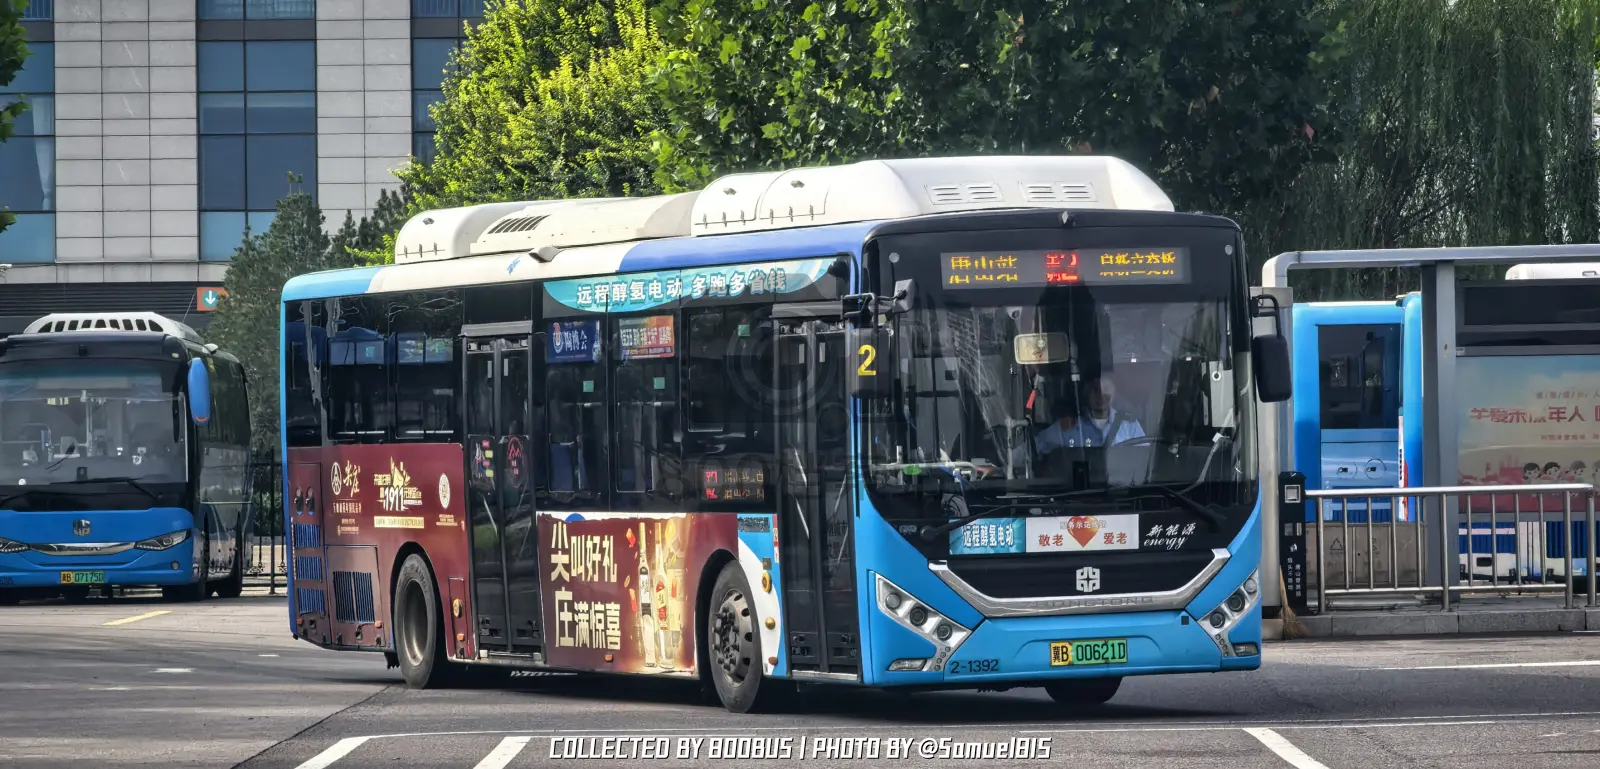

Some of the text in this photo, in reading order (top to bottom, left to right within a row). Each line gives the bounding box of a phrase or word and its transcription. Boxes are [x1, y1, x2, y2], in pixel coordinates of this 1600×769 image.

[577, 268, 787, 305] 远程醇氢电动 多跑多省钱
[857, 344, 877, 377] 2
[963, 523, 1014, 549] 远程醇氢电动
[1038, 531, 1128, 547] 敬老 爱老
[1146, 522, 1196, 538] 新能源
[551, 521, 618, 583] 尖叫好礼
[1144, 536, 1188, 551] energy
[555, 587, 621, 650] 庄满惊喜
[951, 659, 999, 674] 2-1392
